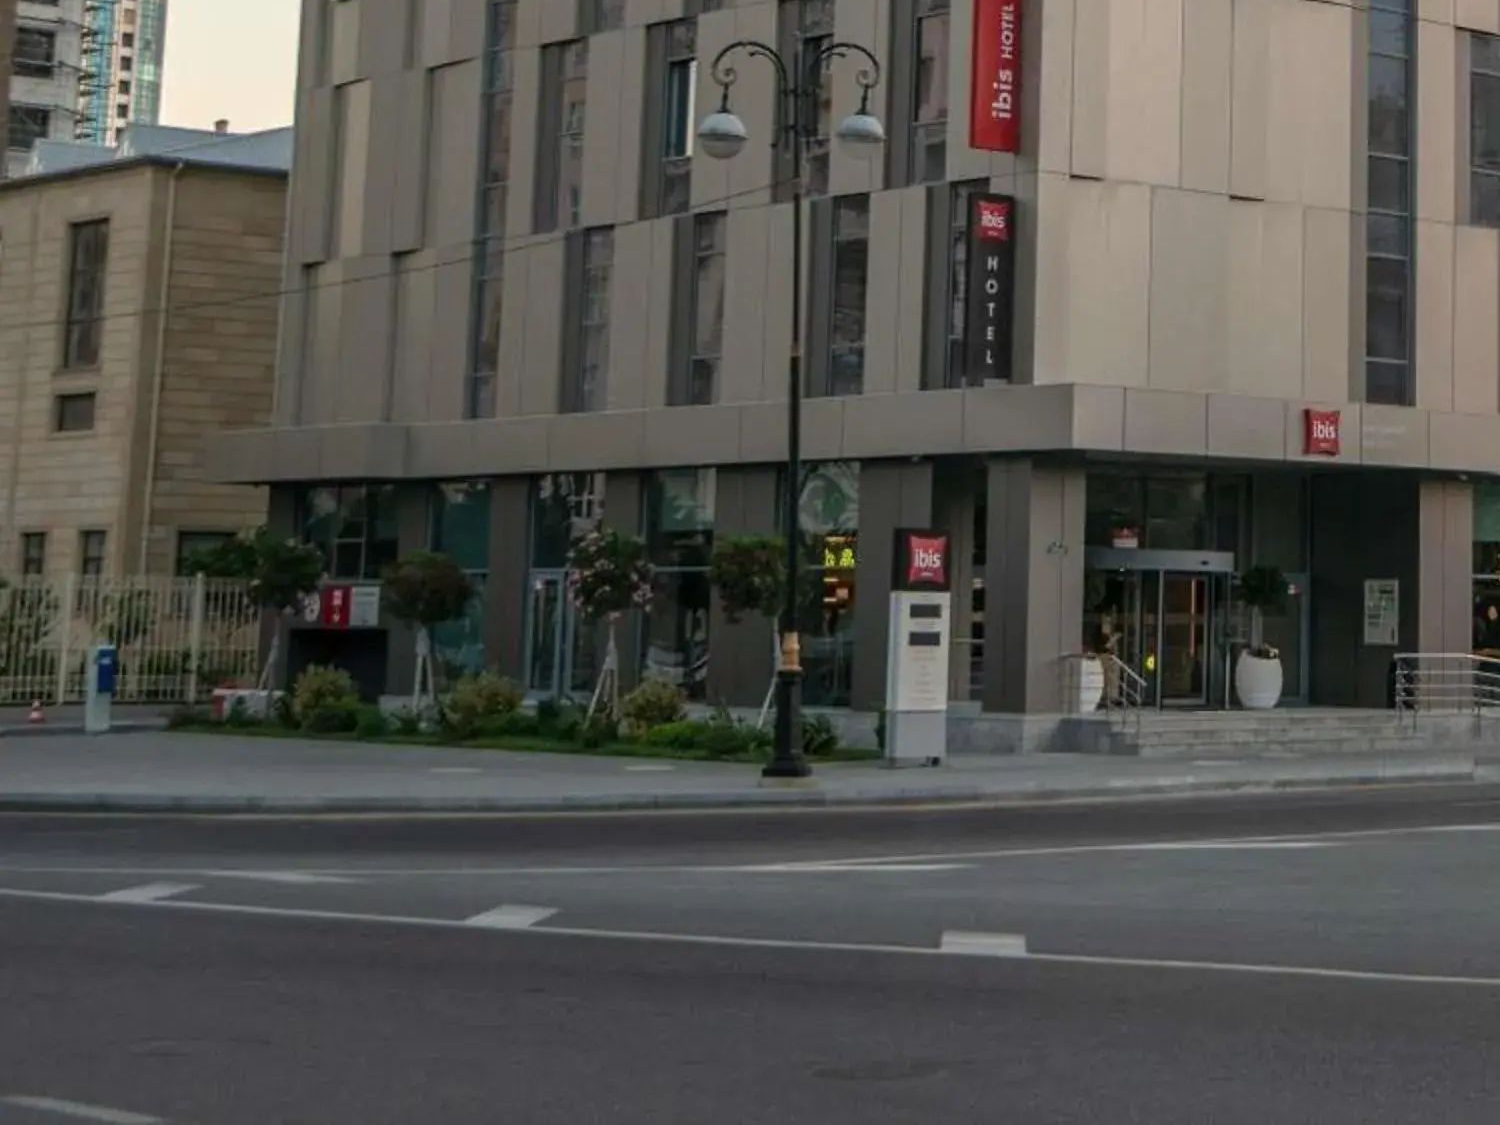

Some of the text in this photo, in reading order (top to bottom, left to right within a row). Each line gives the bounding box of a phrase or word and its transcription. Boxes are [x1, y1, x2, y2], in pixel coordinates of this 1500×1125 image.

[991, 2, 1015, 120] ibis HOTEL
[982, 210, 1005, 228] ibis
[985, 256, 999, 364] HOTEL
[1312, 419, 1337, 439] ibis
[914, 547, 941, 568] ibis
